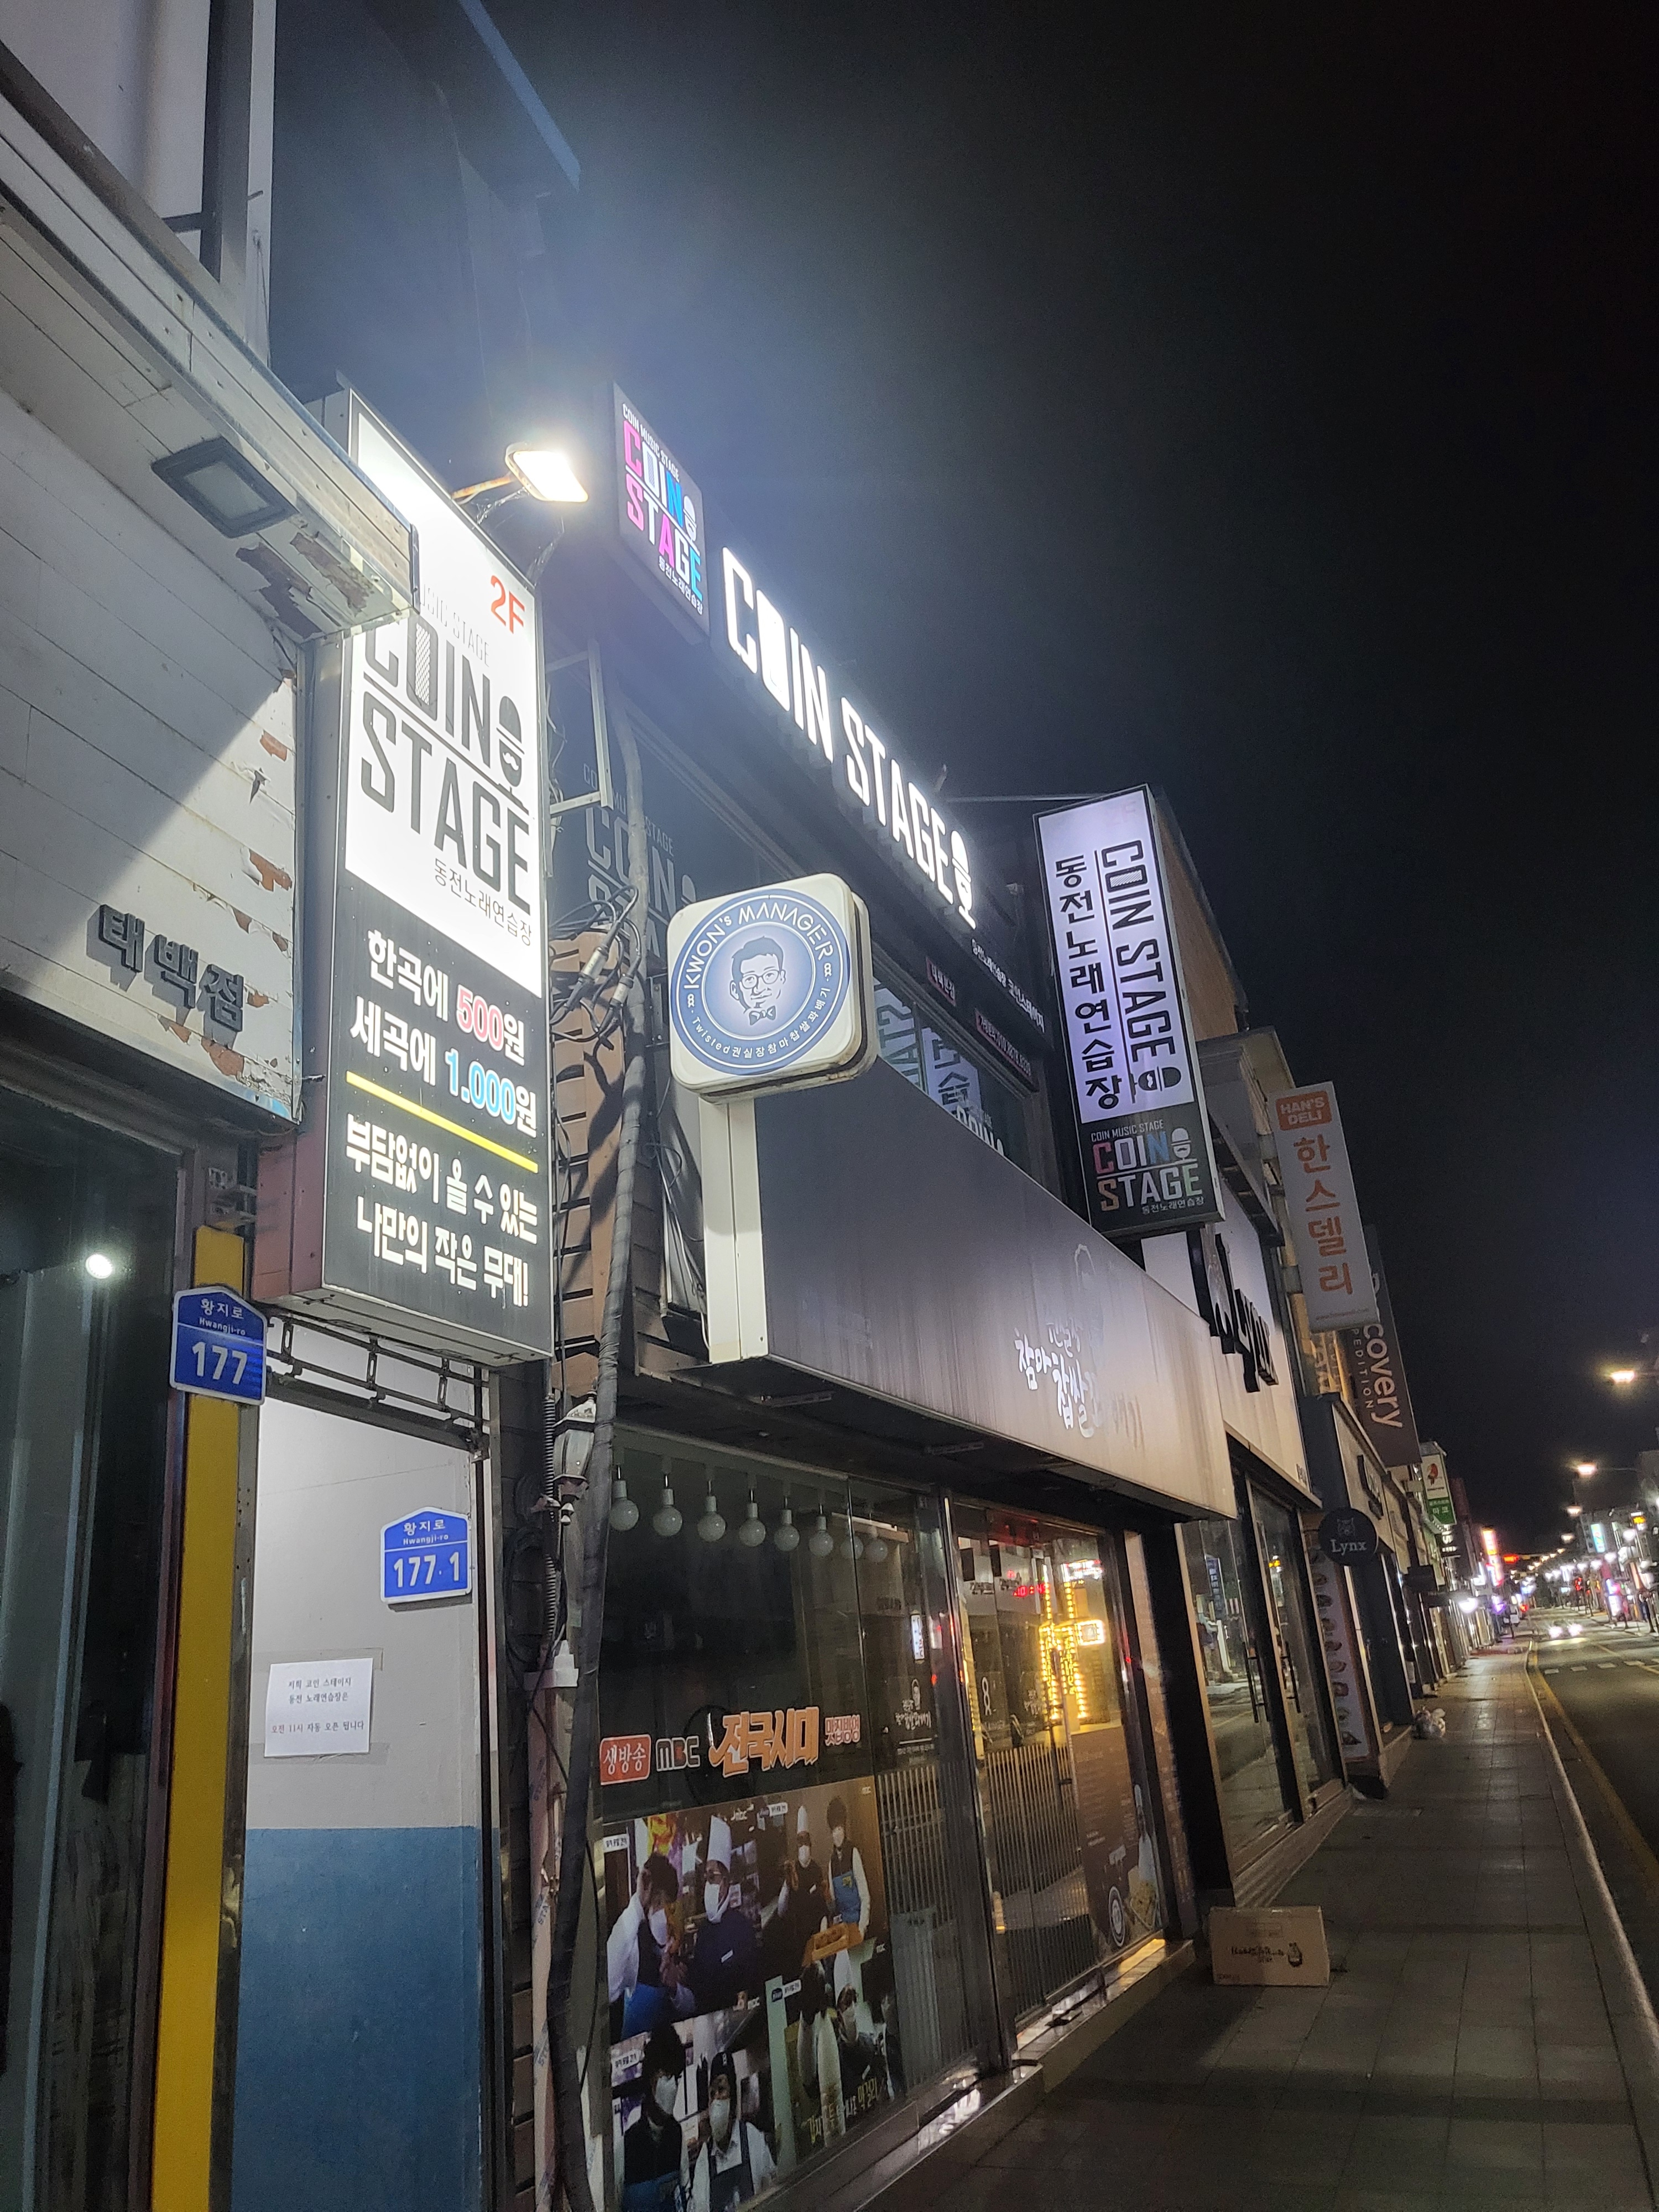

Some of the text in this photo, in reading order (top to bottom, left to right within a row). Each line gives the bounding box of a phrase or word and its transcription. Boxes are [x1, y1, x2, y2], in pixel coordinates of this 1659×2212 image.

[623, 403, 680, 483] COIN MUSIC STAGE
[624, 420, 683, 527] COIN
[626, 474, 703, 601] STAGE
[491, 575, 525, 634] 2F
[659, 555, 703, 615] 동전노래연습장
[420, 584, 489, 667] USIC STAGE
[364, 614, 491, 769] COIN
[722, 547, 953, 905] COIN STAGE
[360, 691, 531, 916] STAGE
[435, 858, 531, 946] 동전노래연습장
[738, 902, 833, 961] MANAGER
[98, 904, 244, 1032] 태백점
[1055, 854, 1122, 1109] 동전노래연습장
[1101, 840, 1176, 1063] COIN STAGE
[368, 929, 525, 1066] 한곡에 500원
[349, 995, 537, 1138] 세곡에 1.000원
[1280, 1097, 1325, 1114] HAN'S
[1091, 1119, 1164, 1142] COIN MUSIC STAGE
[1093, 1131, 1170, 1174] COIN
[346, 1113, 439, 1204] 부담없이
[474, 1175, 494, 1224] 수
[500, 1183, 538, 1245] 있는
[1098, 1163, 1203, 1211] STAGE
[1142, 1197, 1204, 1214] 동전노래연습장
[1293, 1133, 1353, 1295] 한스델리
[357, 1196, 528, 1307] 나만의 작은 무대!
[199, 1317, 246, 1336] Hwangji-ro
[201, 1298, 244, 1319] 황지로
[192, 1341, 247, 1385] 177
[1352, 1328, 1374, 1408] PEDITION
[1364, 1324, 1403, 1428] covery
[403, 1534, 449, 1546] Hwangji-ro
[404, 1519, 446, 1536] 황지로
[1331, 1539, 1367, 1554] Lynx
[306, 1678, 320, 1688] 코인
[323, 1677, 351, 1687] 스테이지
[272, 1724, 285, 1734] 오전
[289, 1724, 303, 1733] 11시
[343, 1720, 364, 1731] 됩니다
[603, 1742, 646, 1775] 생방송
[656, 1735, 701, 1772] MBC
